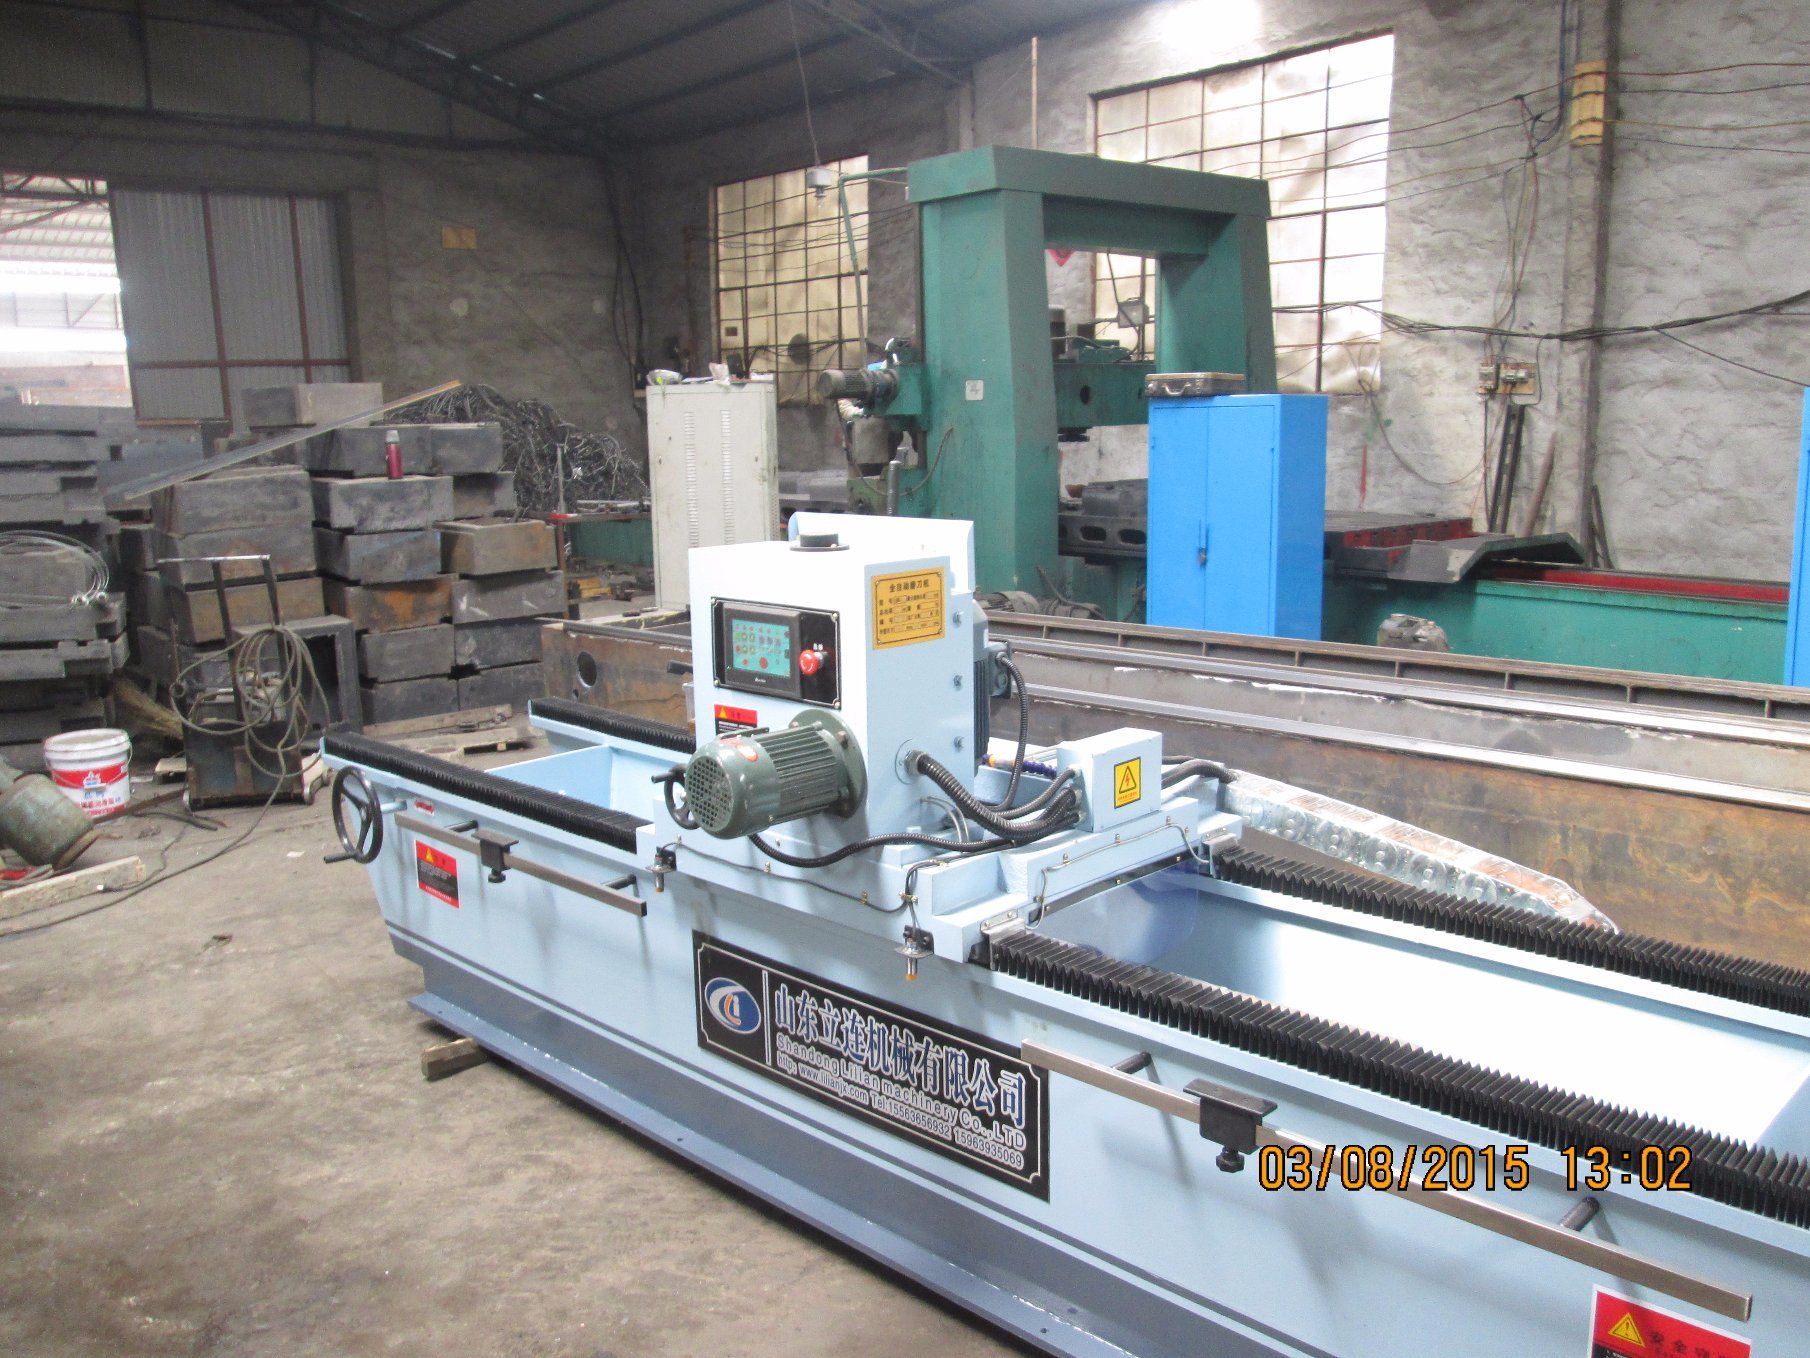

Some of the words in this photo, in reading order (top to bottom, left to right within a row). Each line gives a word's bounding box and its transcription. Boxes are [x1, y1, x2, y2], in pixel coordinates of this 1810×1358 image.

[775, 983, 1025, 1129] 山东立连机械有限公司
[776, 1032, 840, 1077] Shandong
[840, 1058, 881, 1092] Lilian
[881, 1078, 958, 1126] machinery
[798, 1062, 869, 1105] www.lilianjx.com
[870, 1090, 952, 1140] Tel:15563656932
[953, 1126, 1024, 1170] 15963935069
